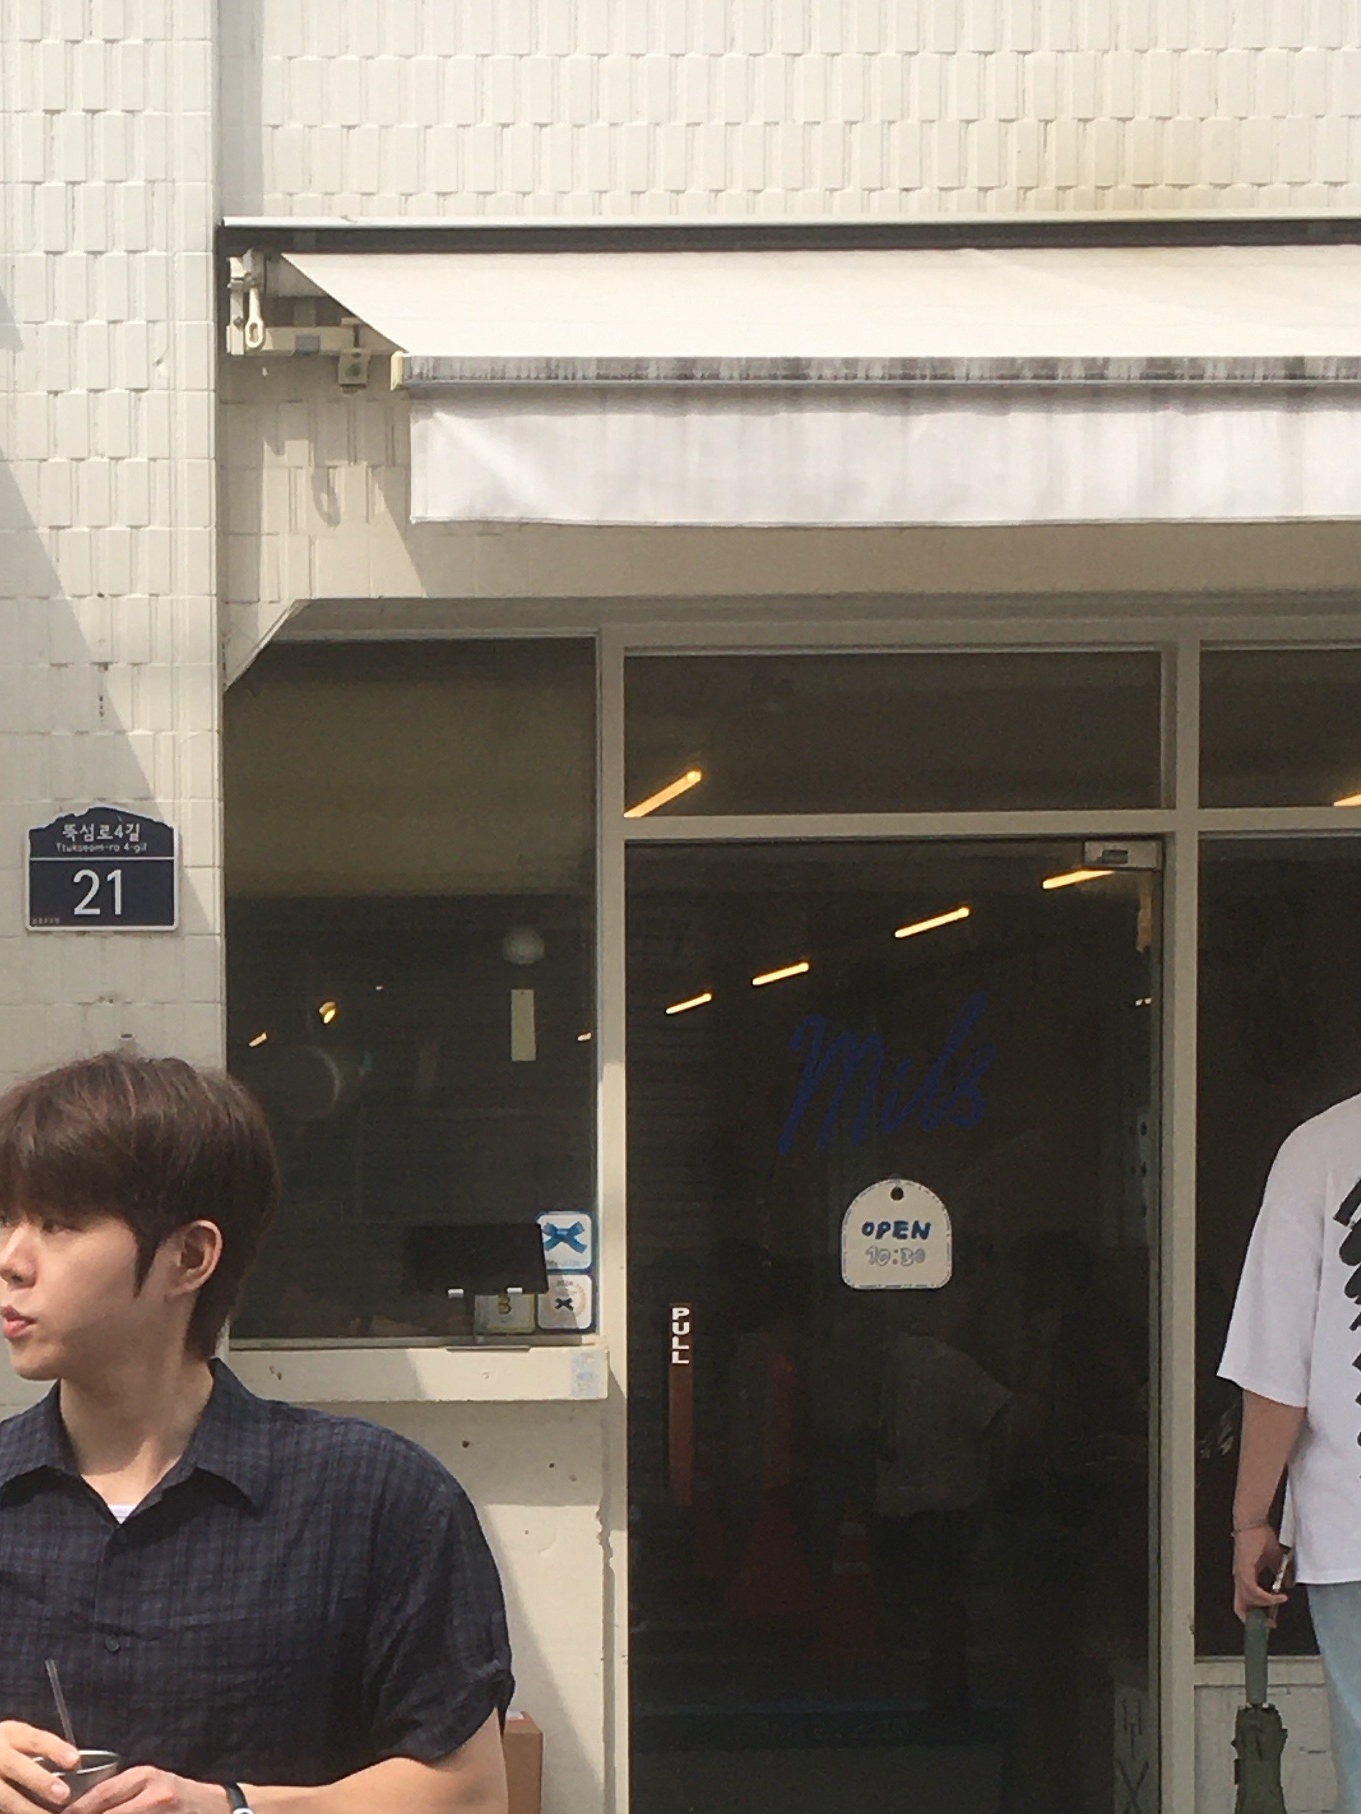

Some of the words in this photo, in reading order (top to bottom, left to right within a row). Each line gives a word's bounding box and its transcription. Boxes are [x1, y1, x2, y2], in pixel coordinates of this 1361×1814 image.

[62, 823, 140, 842] 뚝섬로4길
[73, 869, 122, 915] 21
[861, 1220, 931, 1240] OPEN
[671, 1307, 690, 1364] PULL
